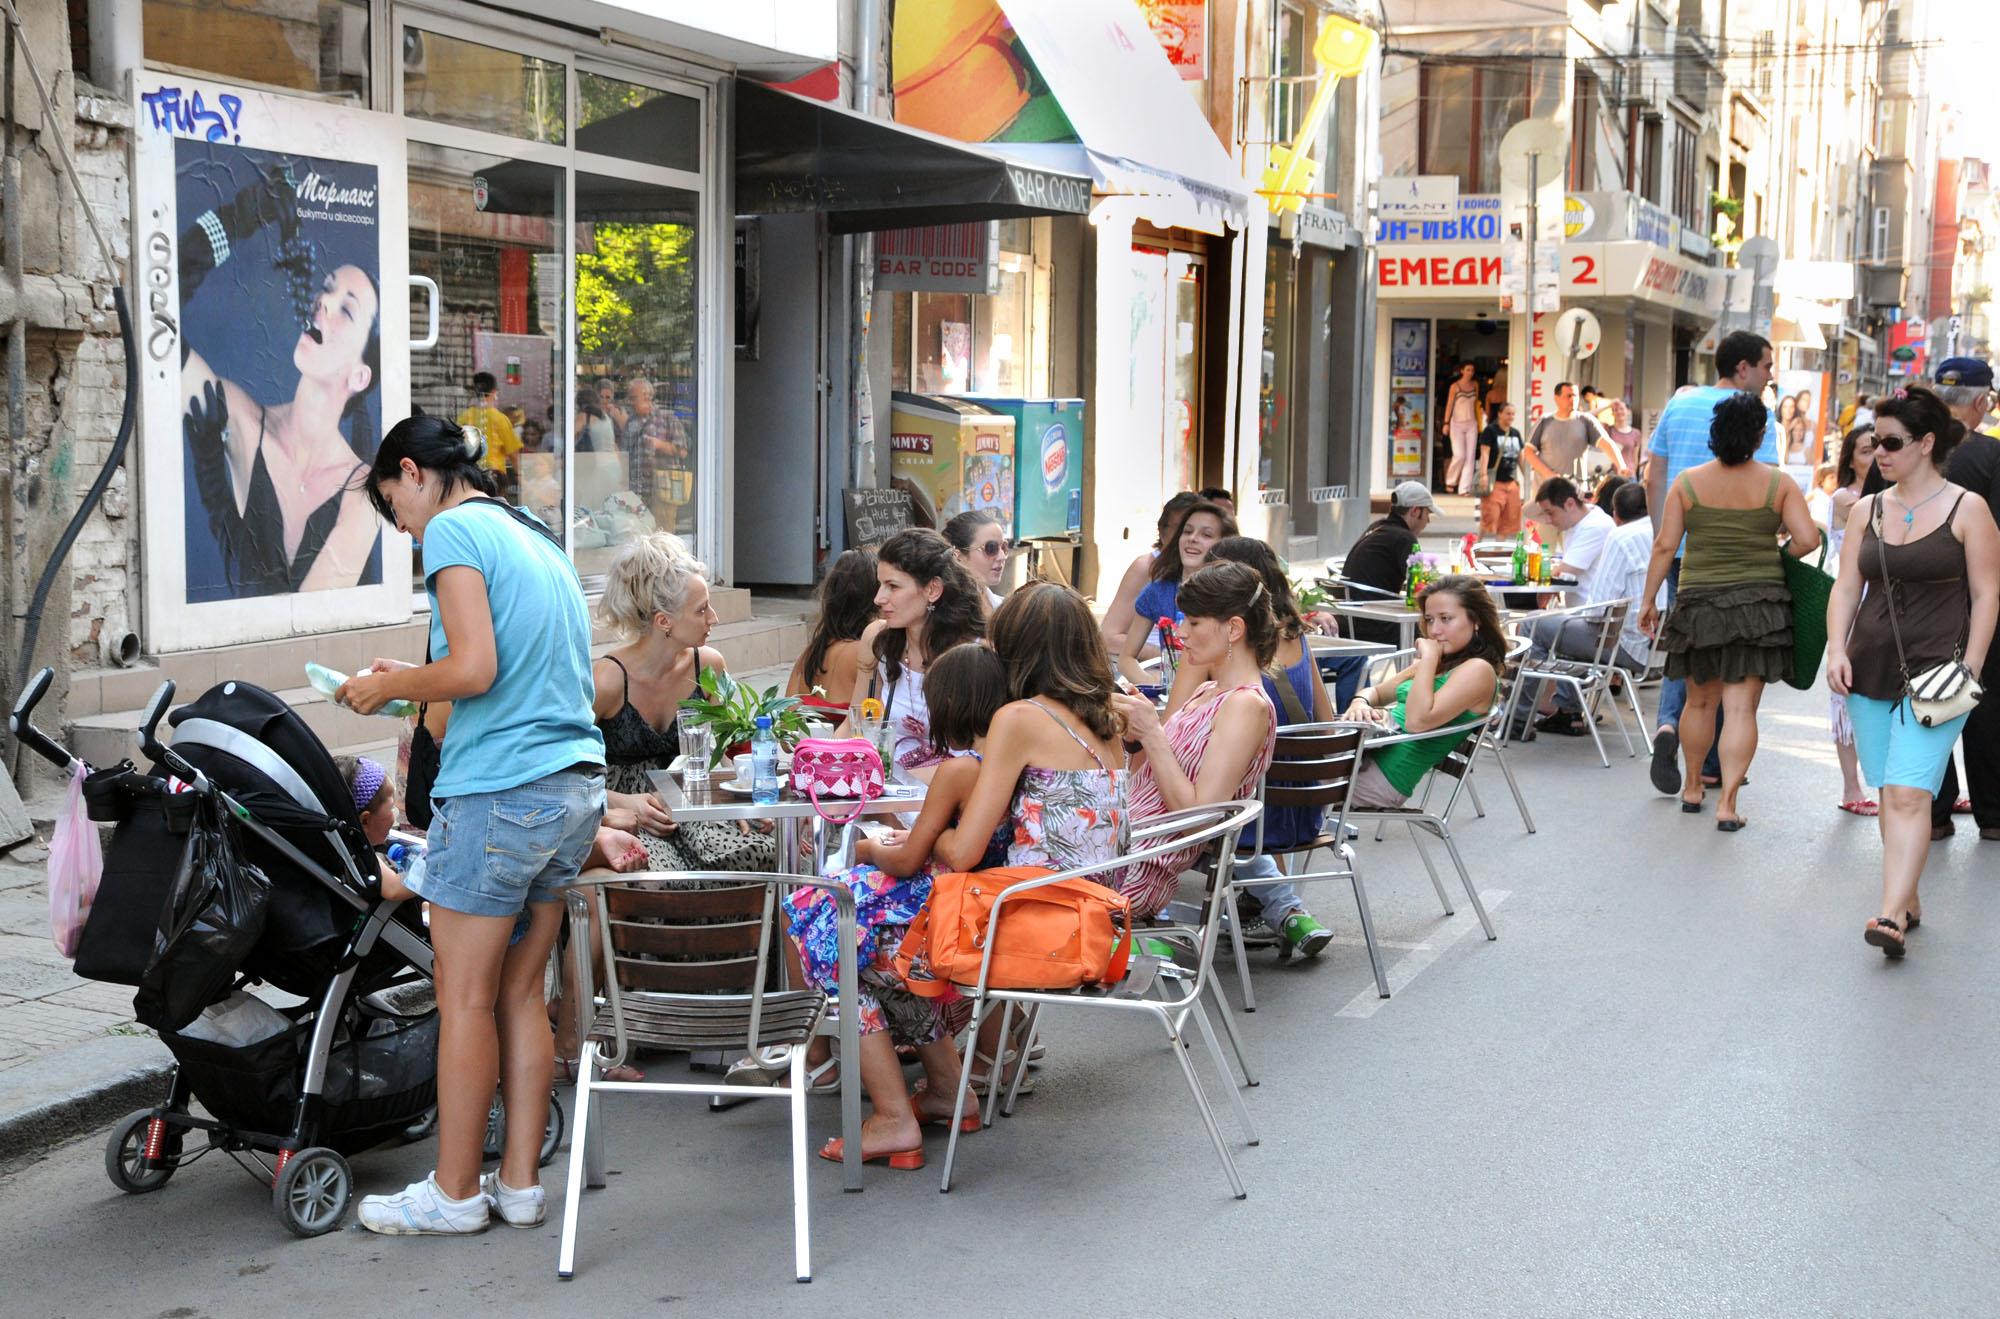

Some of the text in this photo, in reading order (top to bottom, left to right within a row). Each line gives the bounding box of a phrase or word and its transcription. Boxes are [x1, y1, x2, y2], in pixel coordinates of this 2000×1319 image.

[1014, 169, 1089, 211] BAR CODE
[1464, 198, 1501, 210] КОНСО
[1303, 211, 1346, 235] FRANT
[1376, 214, 1501, 241] Н-ИВКО
[879, 259, 977, 277] BAR CODE
[1571, 255, 1598, 285] 2
